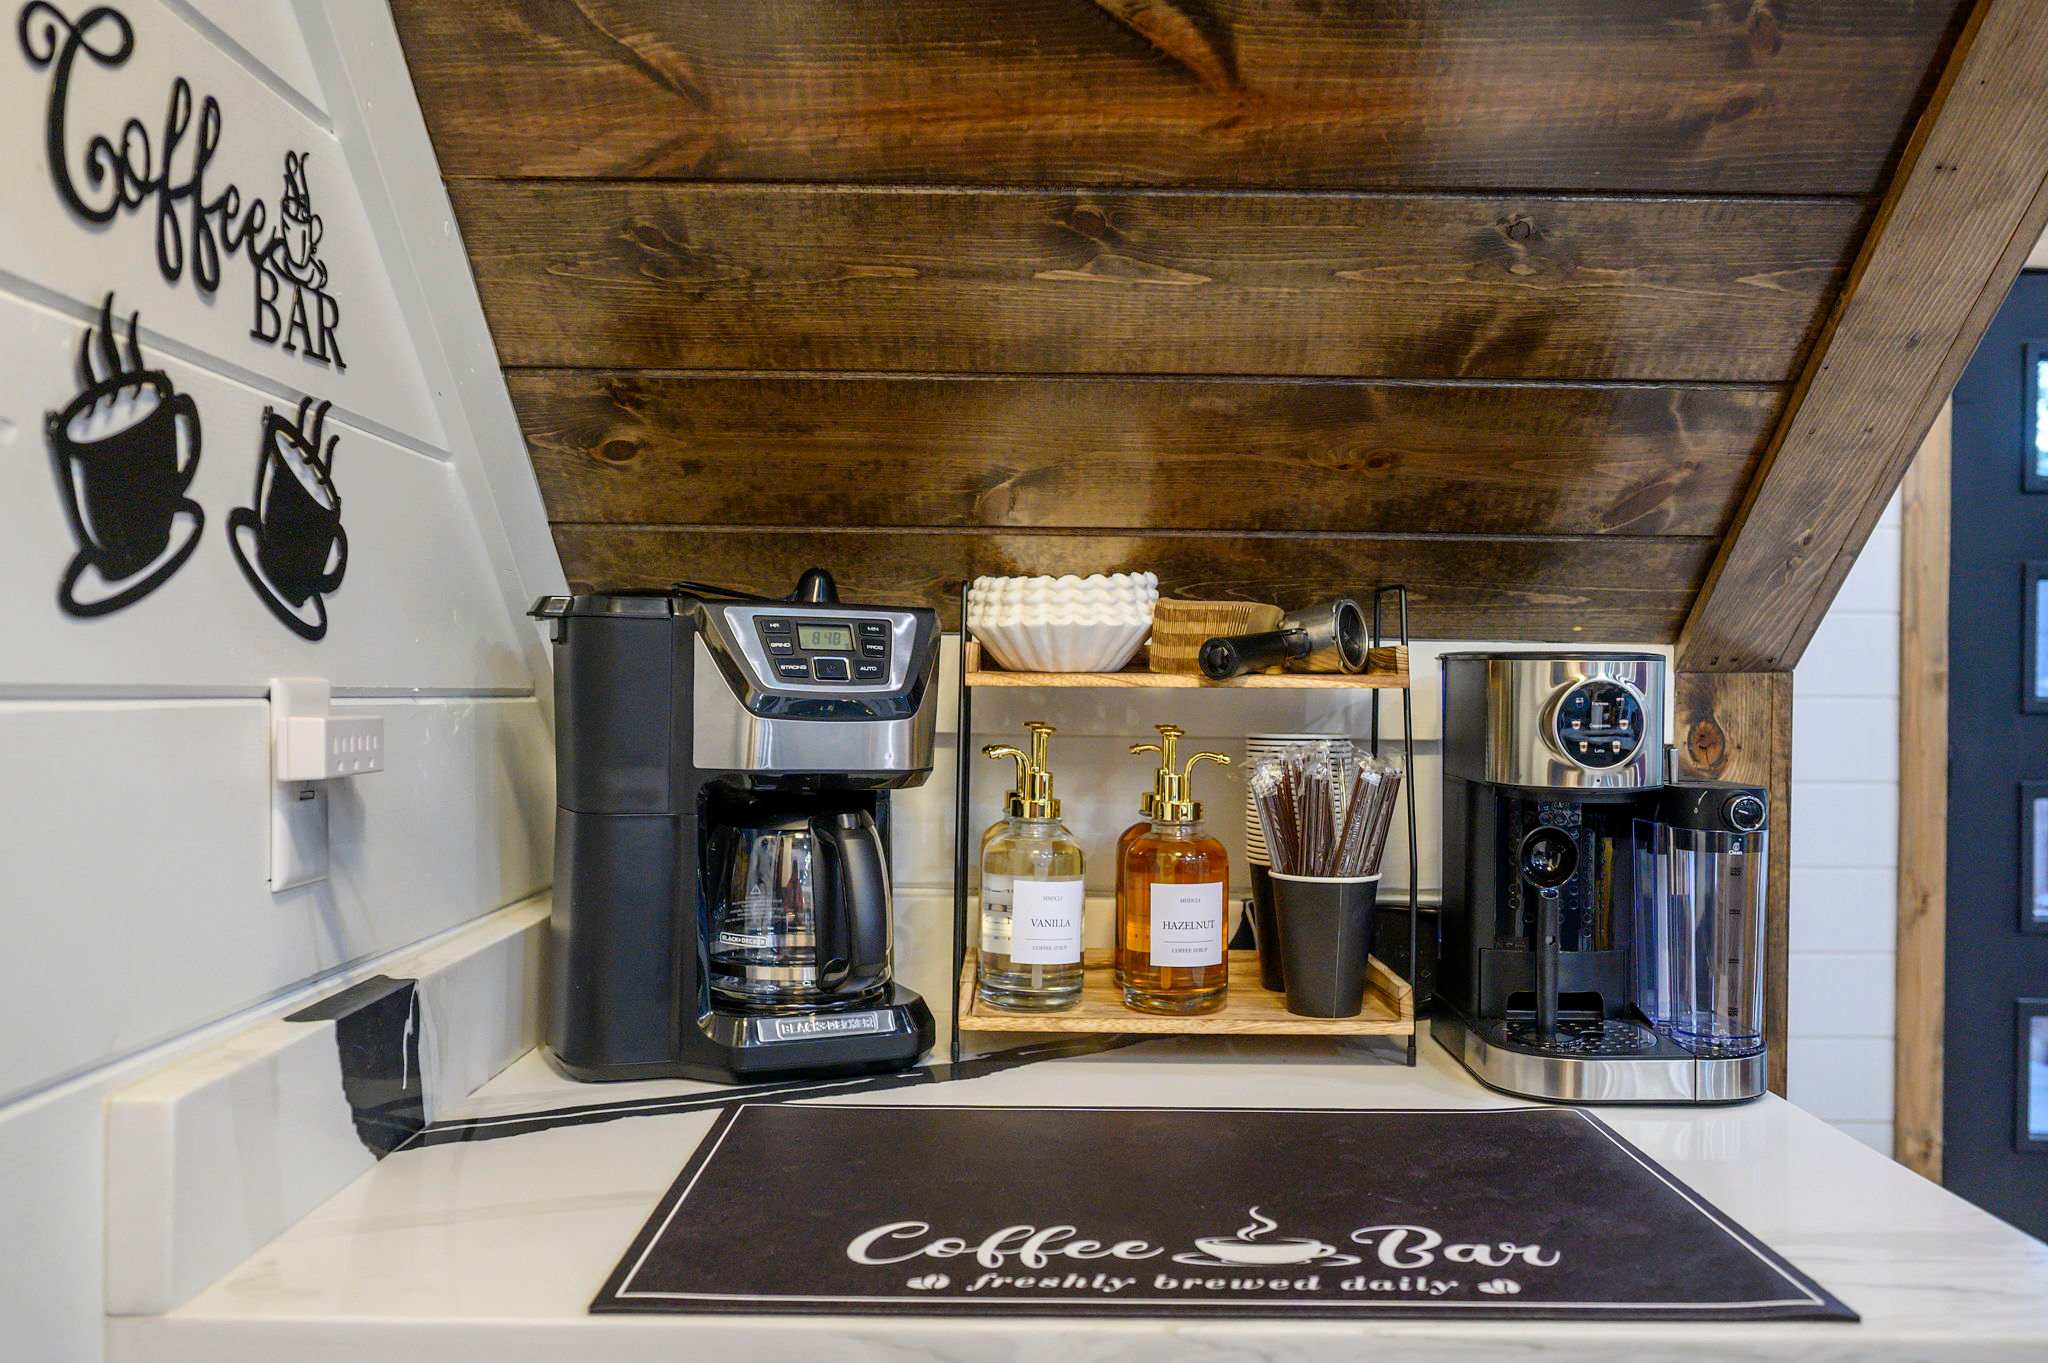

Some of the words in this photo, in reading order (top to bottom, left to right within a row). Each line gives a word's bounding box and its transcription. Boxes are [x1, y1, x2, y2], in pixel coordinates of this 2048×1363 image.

[19, 0, 284, 292] Coffee
[250, 264, 347, 369] BAR
[1031, 919, 1071, 928] VANILLA
[1162, 919, 1216, 931] HAZELNUT
[846, 1220, 1165, 1269] Coffee
[1351, 1224, 1561, 1269] Bar
[965, 1272, 1137, 1293] freshly
[1154, 1274, 1321, 1291] brewed
[1340, 1275, 1459, 1295] daily
